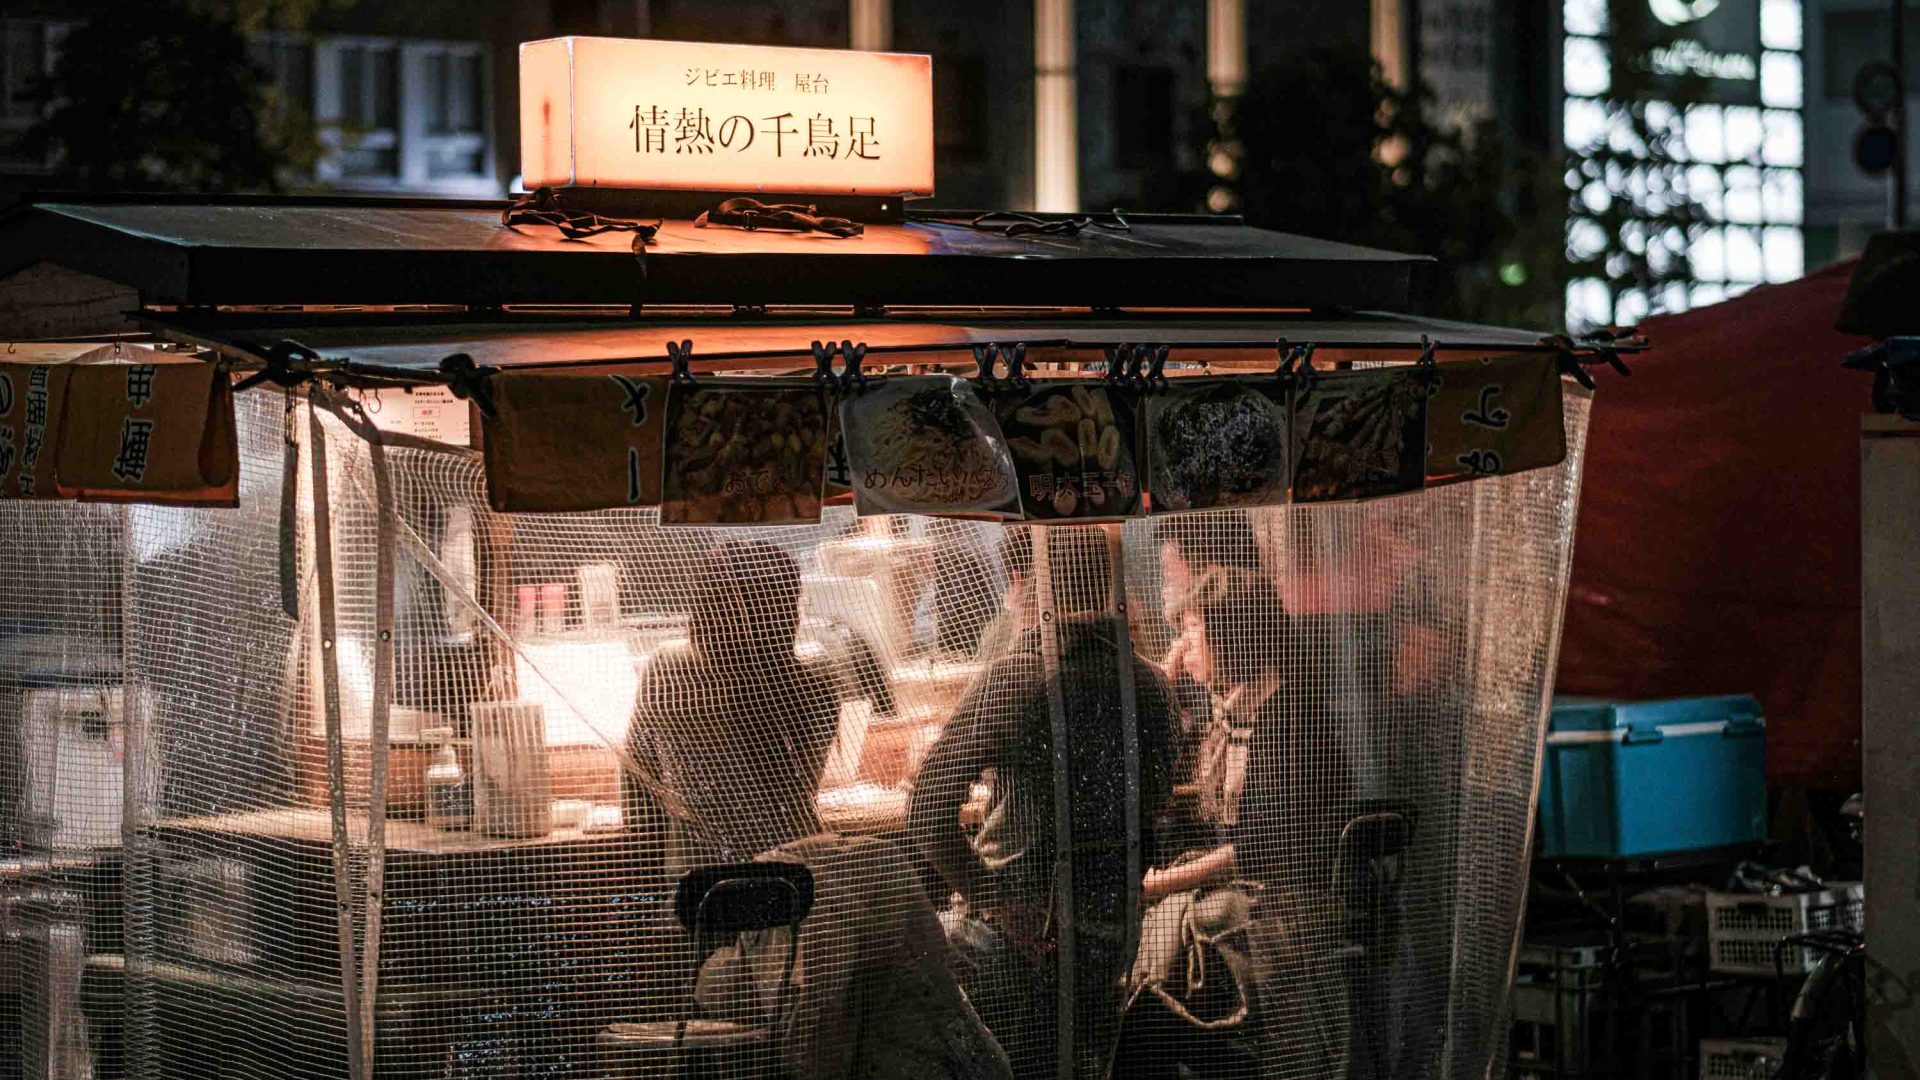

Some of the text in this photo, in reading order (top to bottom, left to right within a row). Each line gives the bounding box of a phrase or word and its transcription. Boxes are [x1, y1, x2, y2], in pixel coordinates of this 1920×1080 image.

[684, 67, 830, 94] ジビエ料理 屋台
[629, 104, 881, 160] 情熱の千鳥足
